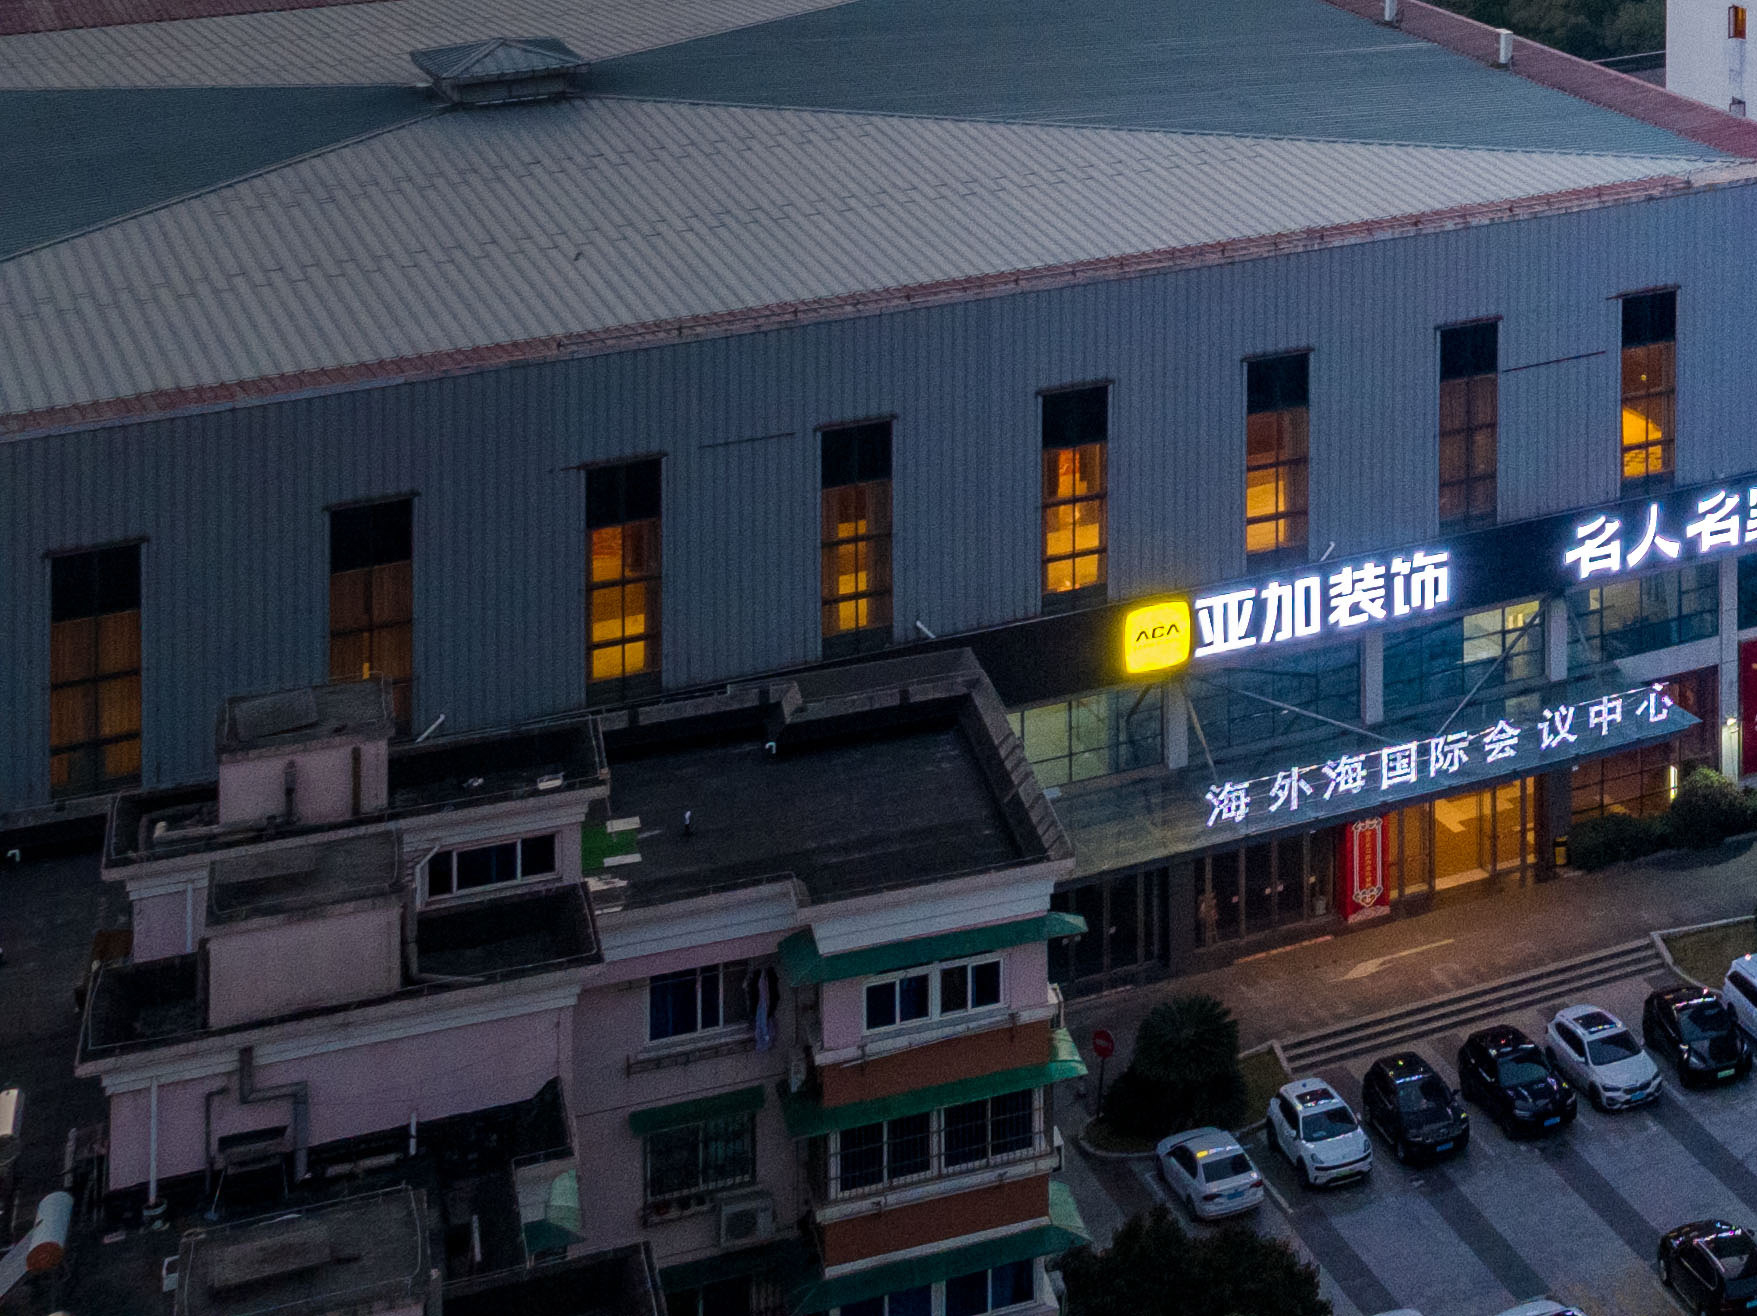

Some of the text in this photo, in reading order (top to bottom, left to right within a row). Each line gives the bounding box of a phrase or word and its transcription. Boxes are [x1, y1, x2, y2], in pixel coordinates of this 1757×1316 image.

[1193, 550, 1451, 661] 亚加装饰
[1204, 682, 1676, 828] 海外海国际会议中心
